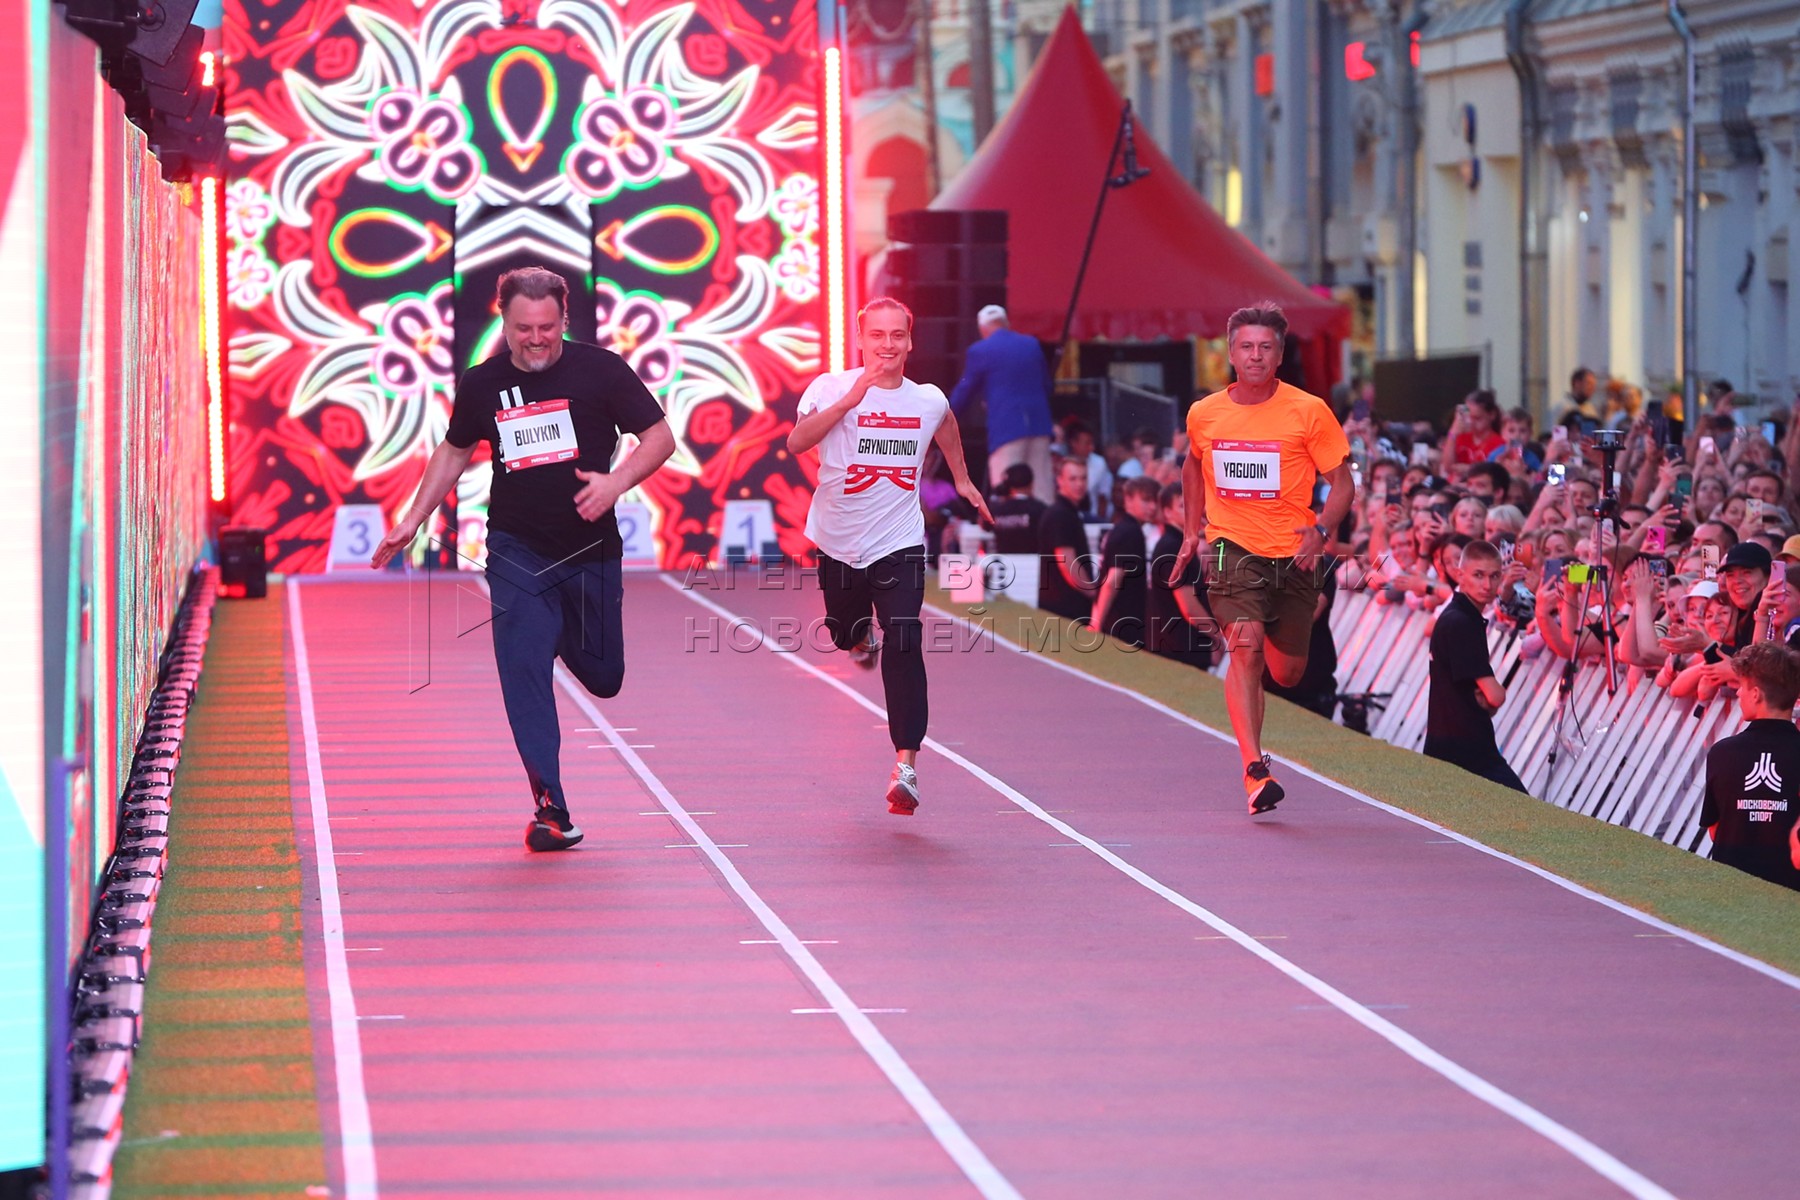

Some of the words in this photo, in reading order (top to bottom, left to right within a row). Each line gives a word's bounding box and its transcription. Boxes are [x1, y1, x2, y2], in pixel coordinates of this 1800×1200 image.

[514, 423, 561, 447] BULYKIN
[1223, 461, 1268, 479] YAGUDIN
[347, 519, 371, 556] 3
[617, 517, 638, 552] 2
[737, 513, 753, 549] 1
[1736, 799, 1788, 811] МОСКОВСКИЙ
[1749, 811, 1773, 822] СПОРТ
